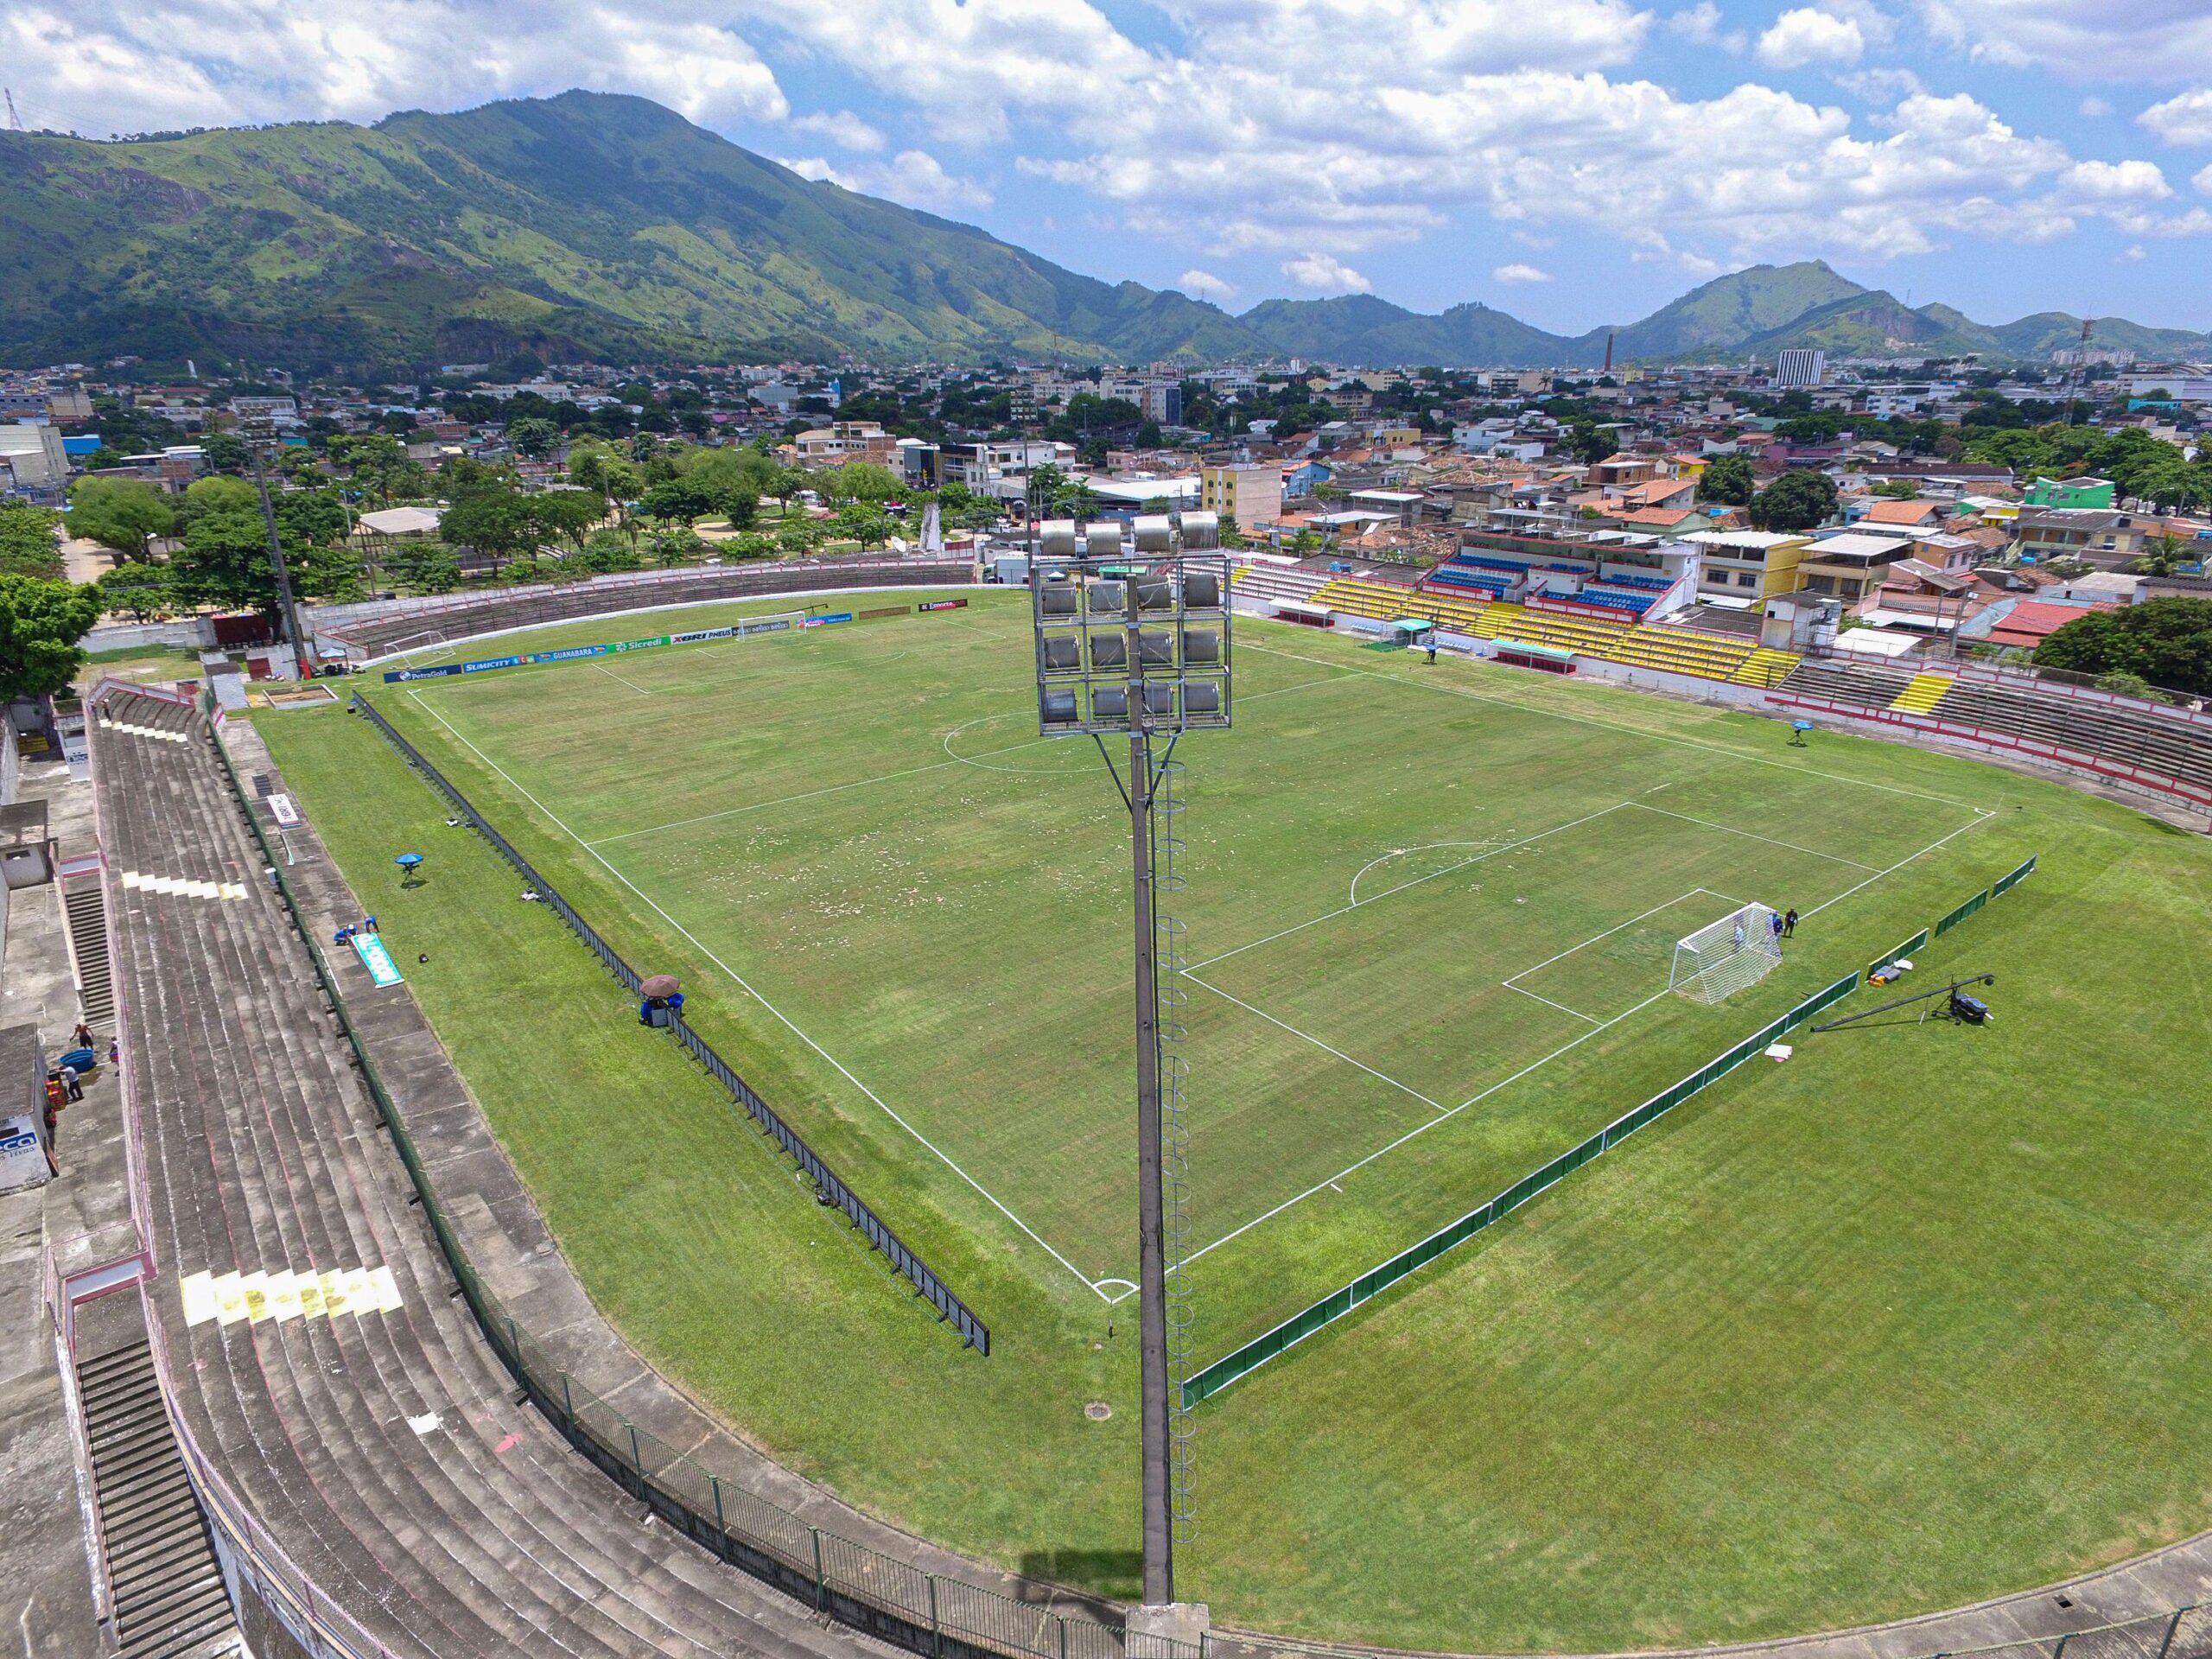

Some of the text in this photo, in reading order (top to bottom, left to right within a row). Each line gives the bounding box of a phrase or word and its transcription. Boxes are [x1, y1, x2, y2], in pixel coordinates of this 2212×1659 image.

[709, 629, 731, 639] PNEUS
[628, 639, 662, 650] Sicredi
[553, 648, 592, 659] GUANABARA
[466, 659, 510, 671] SUMICITY
[411, 670, 448, 680] PetraGold
